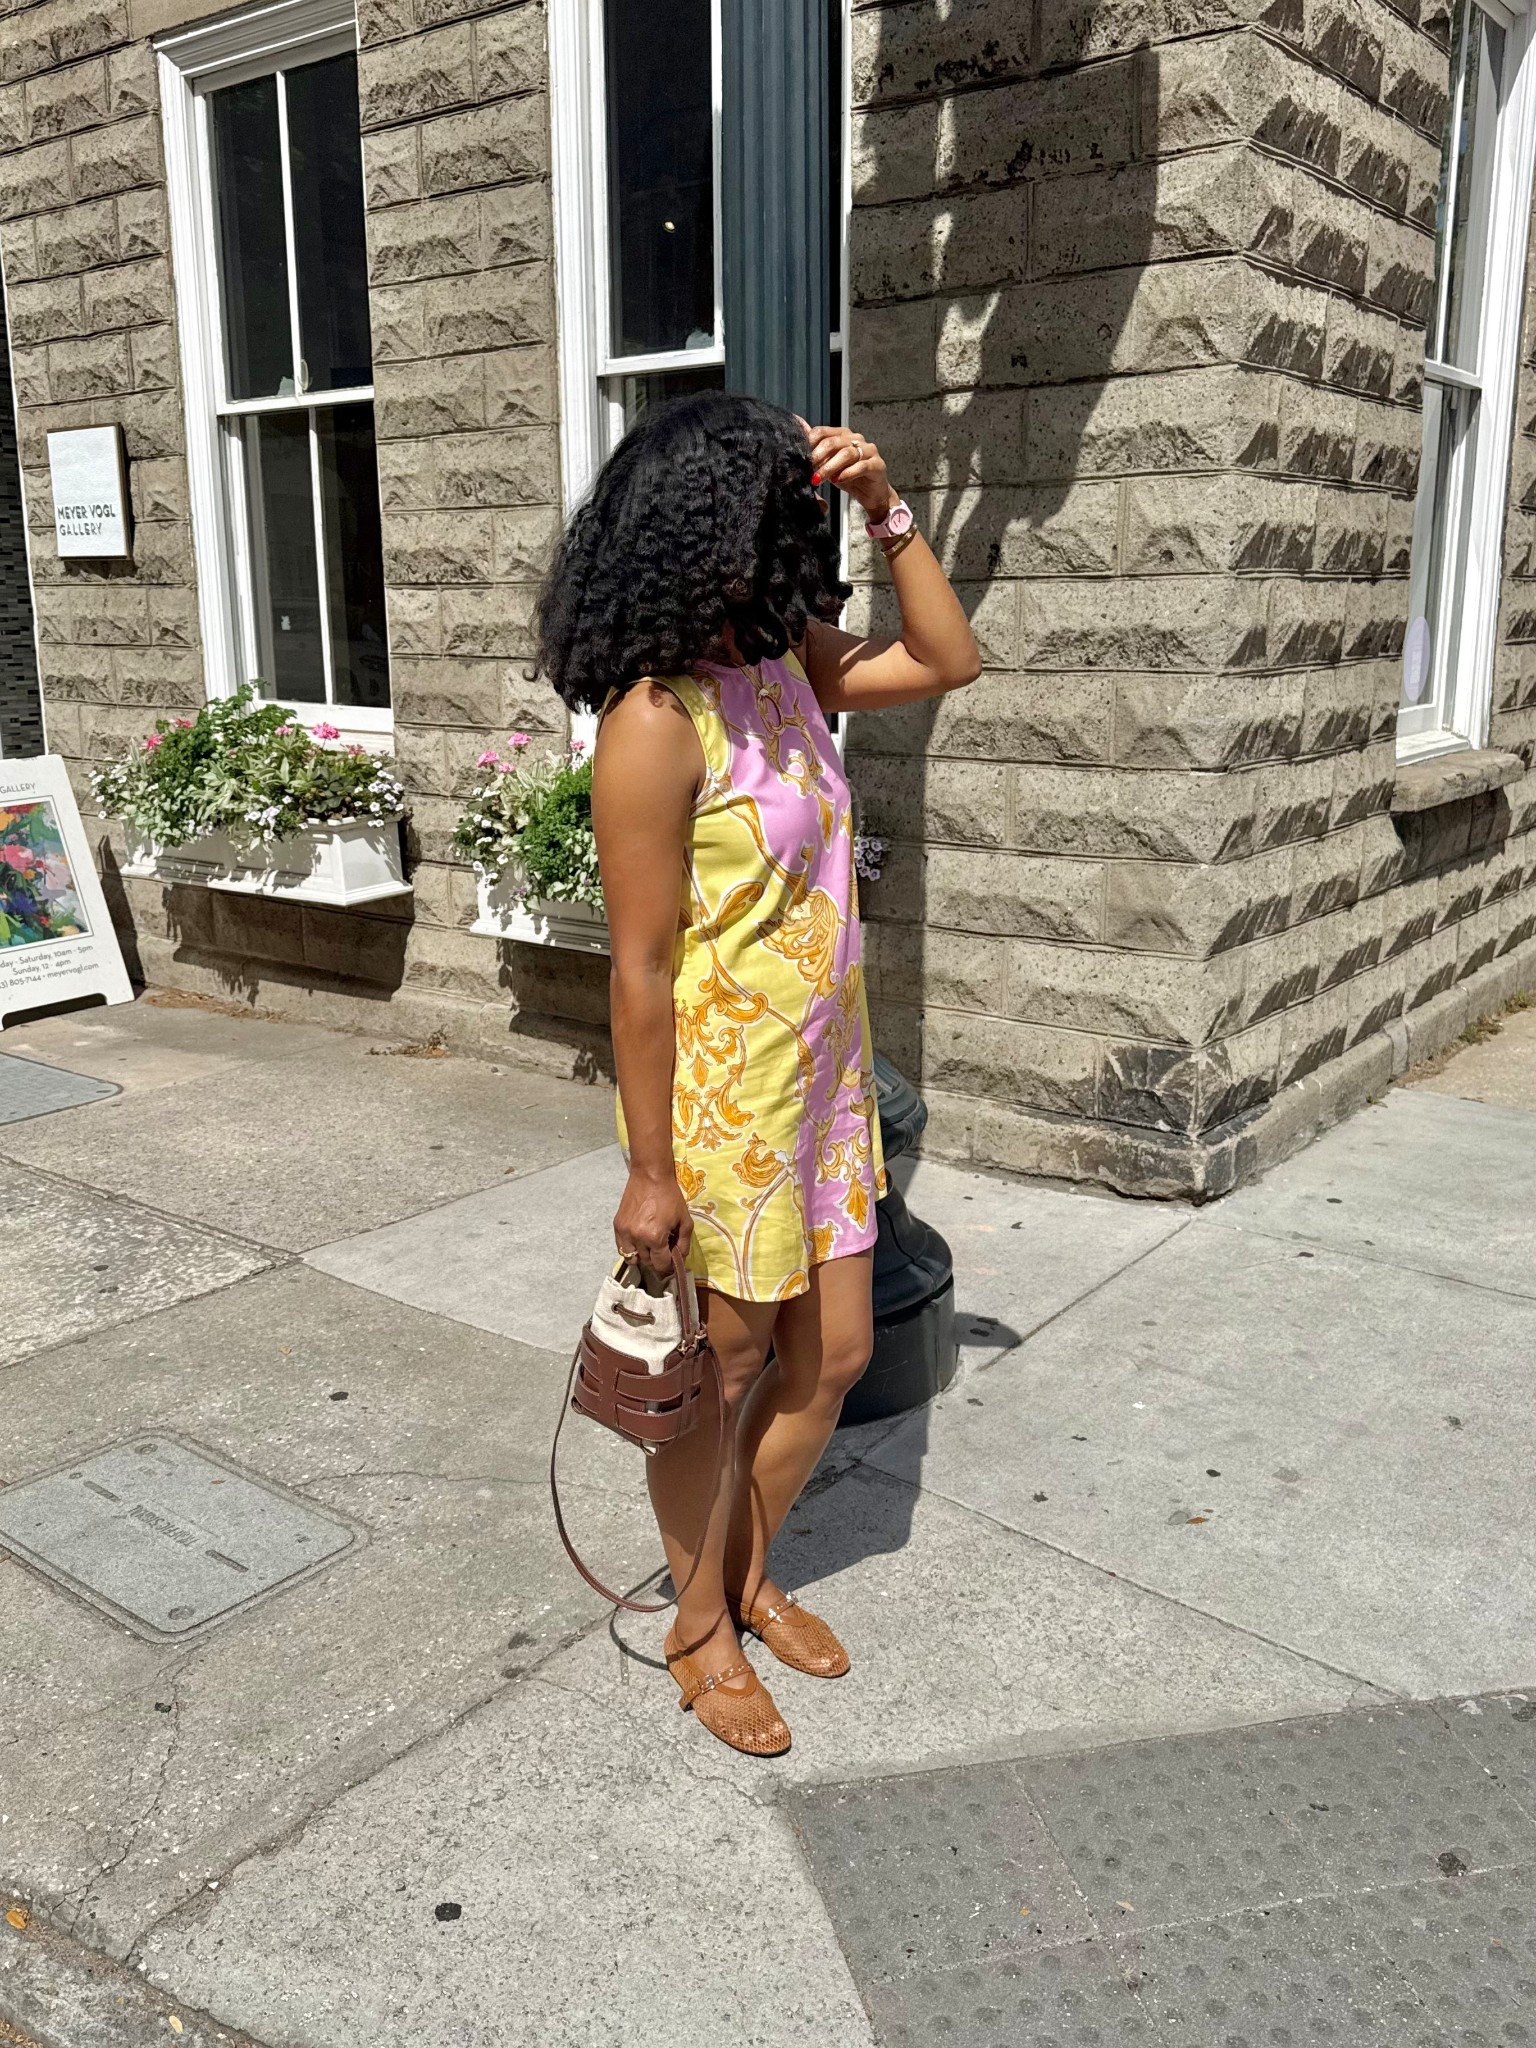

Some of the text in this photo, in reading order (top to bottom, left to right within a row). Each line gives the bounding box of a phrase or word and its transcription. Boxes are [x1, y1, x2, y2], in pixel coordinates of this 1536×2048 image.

[57, 504, 116, 519] MEYER VOGL
[60, 522, 102, 536] GALLERY
[0, 782, 36, 794] GALLERY
[53, 949, 73, 958] 10am
[78, 945, 93, 954] 5pm
[56, 959, 71, 968] 4pm
[9, 975, 41, 986] 805-7144
[47, 963, 99, 978] meyervogl.com
